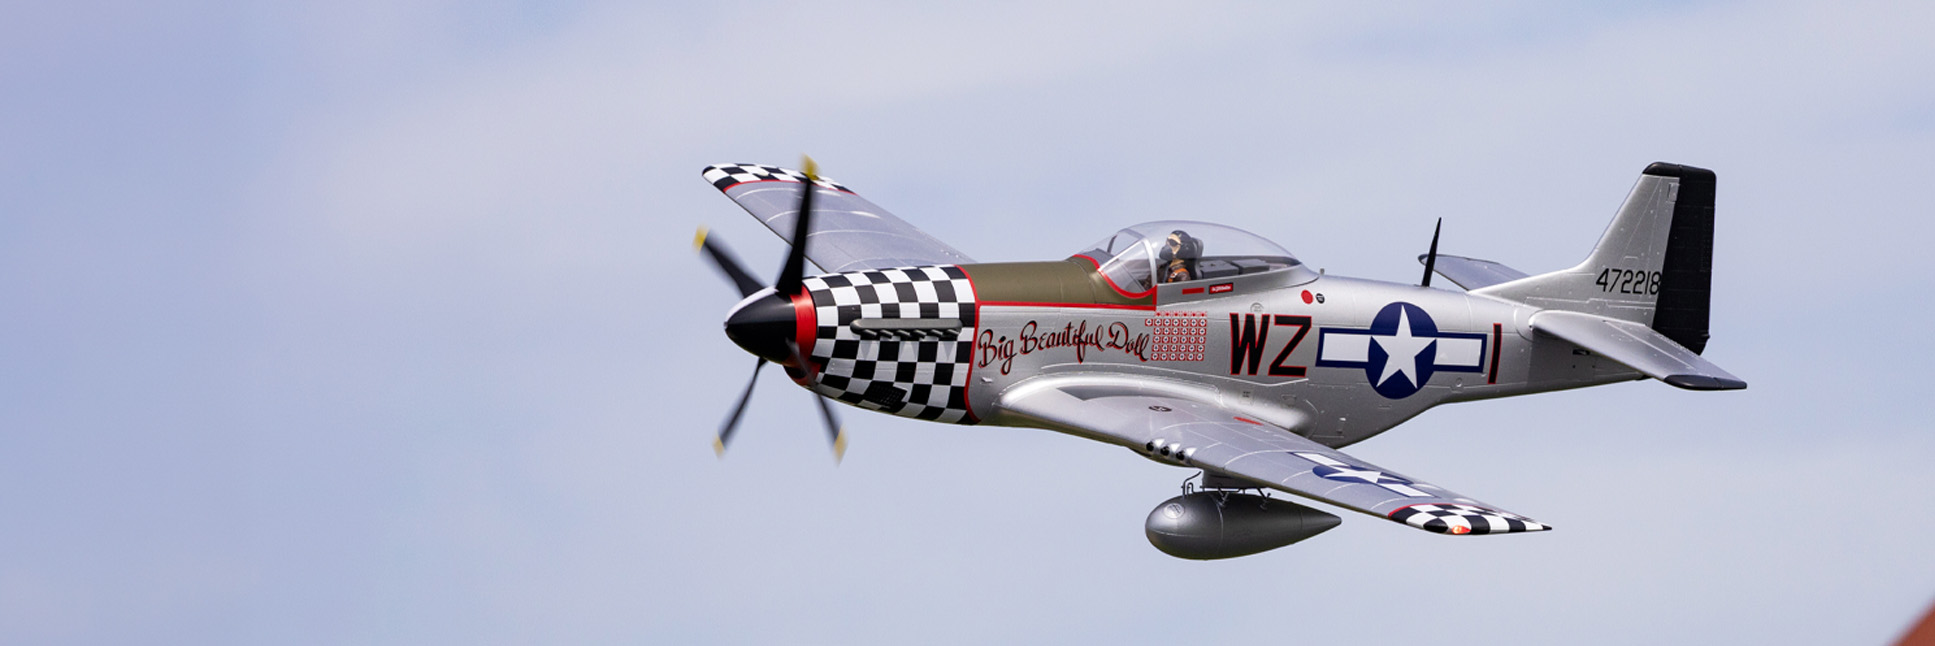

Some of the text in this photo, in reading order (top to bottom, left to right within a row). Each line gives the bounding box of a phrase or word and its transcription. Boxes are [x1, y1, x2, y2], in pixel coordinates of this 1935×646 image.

[1596, 268, 1662, 295] 472218
[977, 320, 1150, 375] Big Beautiful Doll
[1229, 312, 1312, 378] WZ
